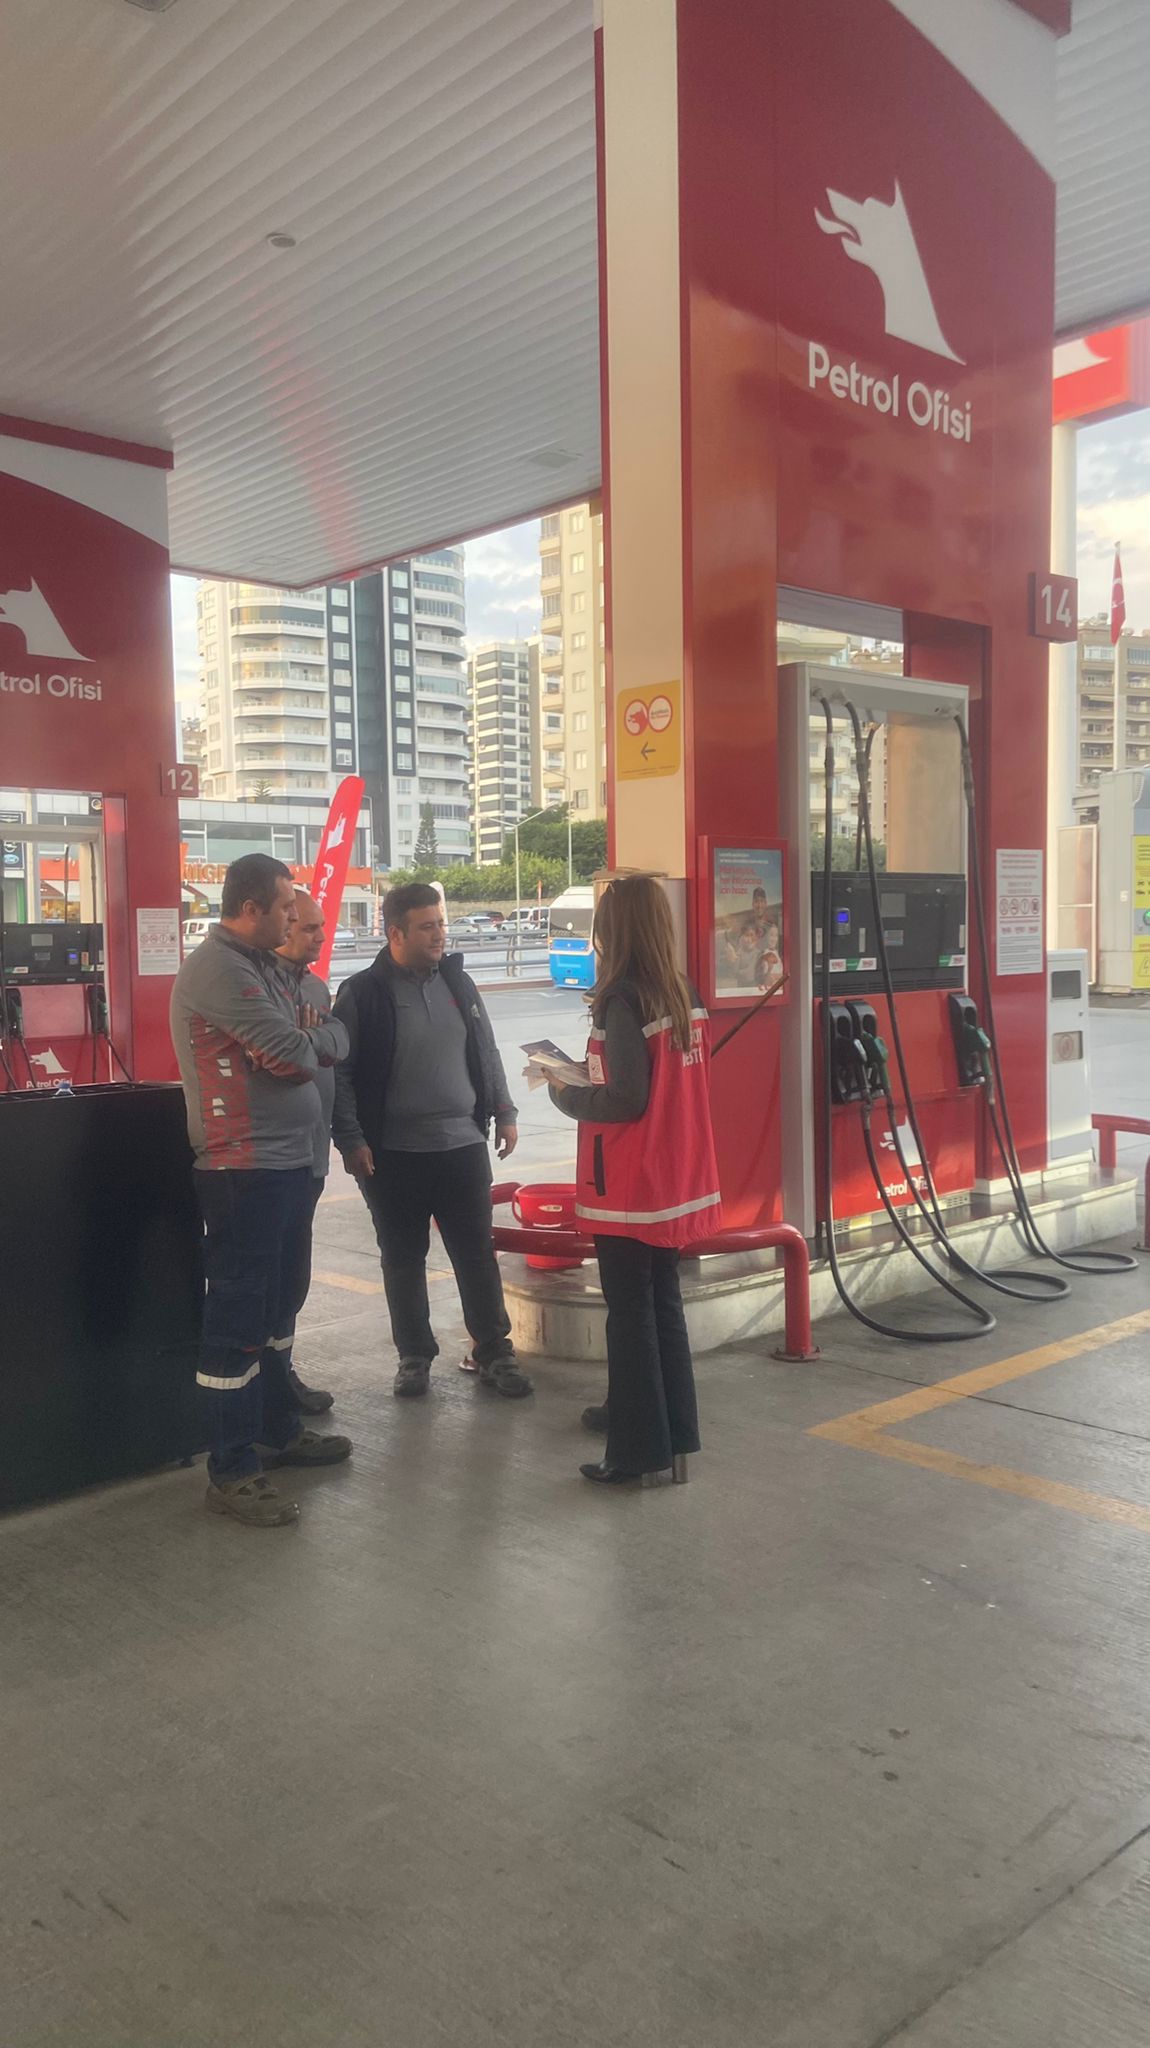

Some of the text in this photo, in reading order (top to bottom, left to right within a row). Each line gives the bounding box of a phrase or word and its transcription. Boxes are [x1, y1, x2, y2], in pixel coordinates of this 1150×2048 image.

[808, 341, 971, 443] Petrol Ofisi
[1041, 584, 1072, 628] 14
[47, 674, 102, 701] Ofisi
[167, 768, 194, 791] 12
